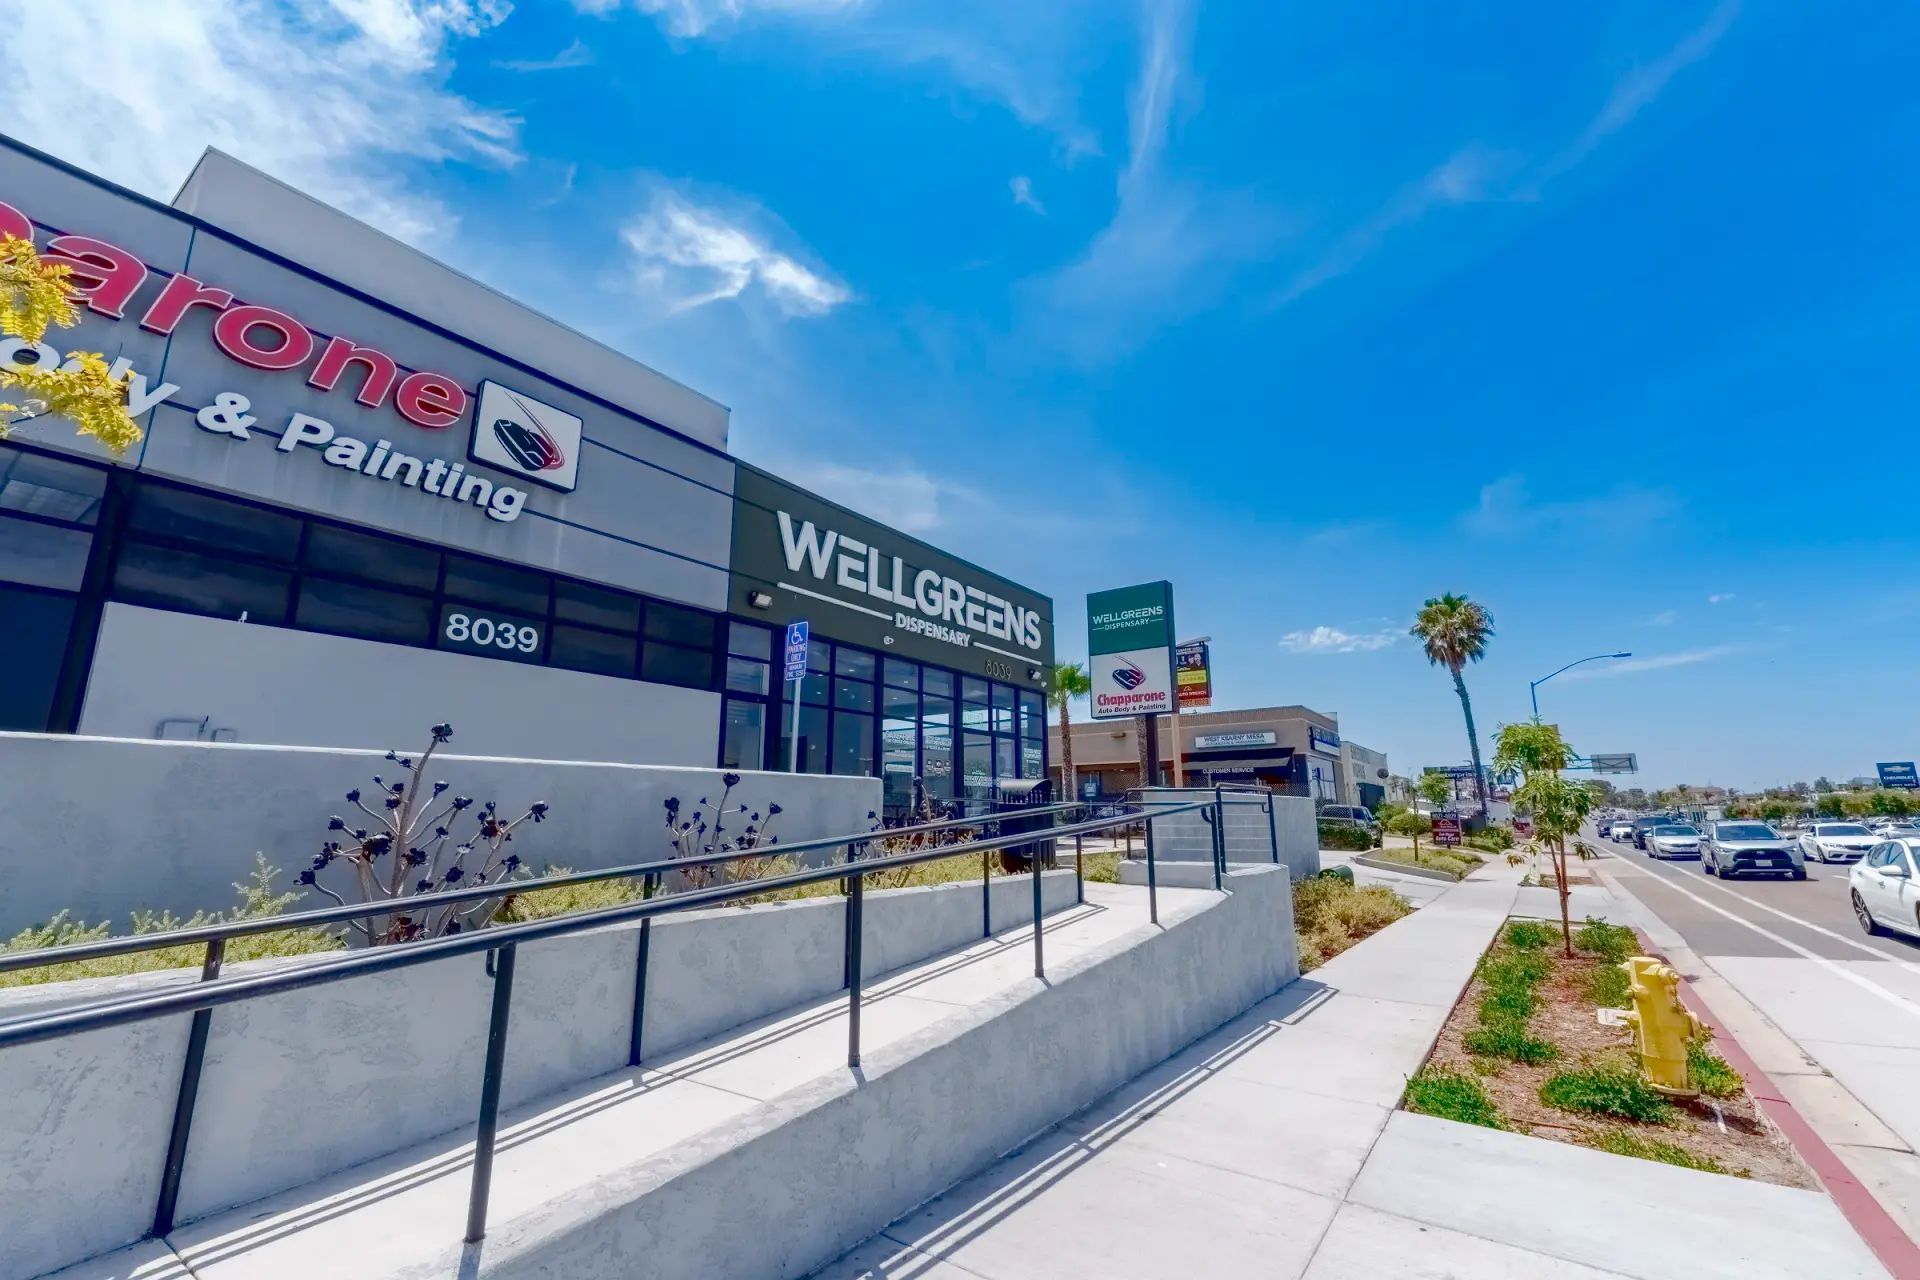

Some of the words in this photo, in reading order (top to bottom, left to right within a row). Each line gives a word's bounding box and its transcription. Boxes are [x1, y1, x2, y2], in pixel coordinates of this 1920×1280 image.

[0, 202, 468, 429] arone
[197, 391, 257, 441] &
[277, 412, 528, 523] Painting
[777, 510, 1043, 650] WELLGREENS
[1093, 606, 1163, 624] WELLGREENS
[1104, 618, 1150, 631] DISPENSARY
[445, 613, 540, 653] 8039
[895, 612, 971, 648] DISPENSARY
[986, 659, 1012, 681] 8039
[1097, 691, 1166, 707] Chapparone
[1114, 706, 1130, 714] Body
[1138, 703, 1166, 711] Painting
